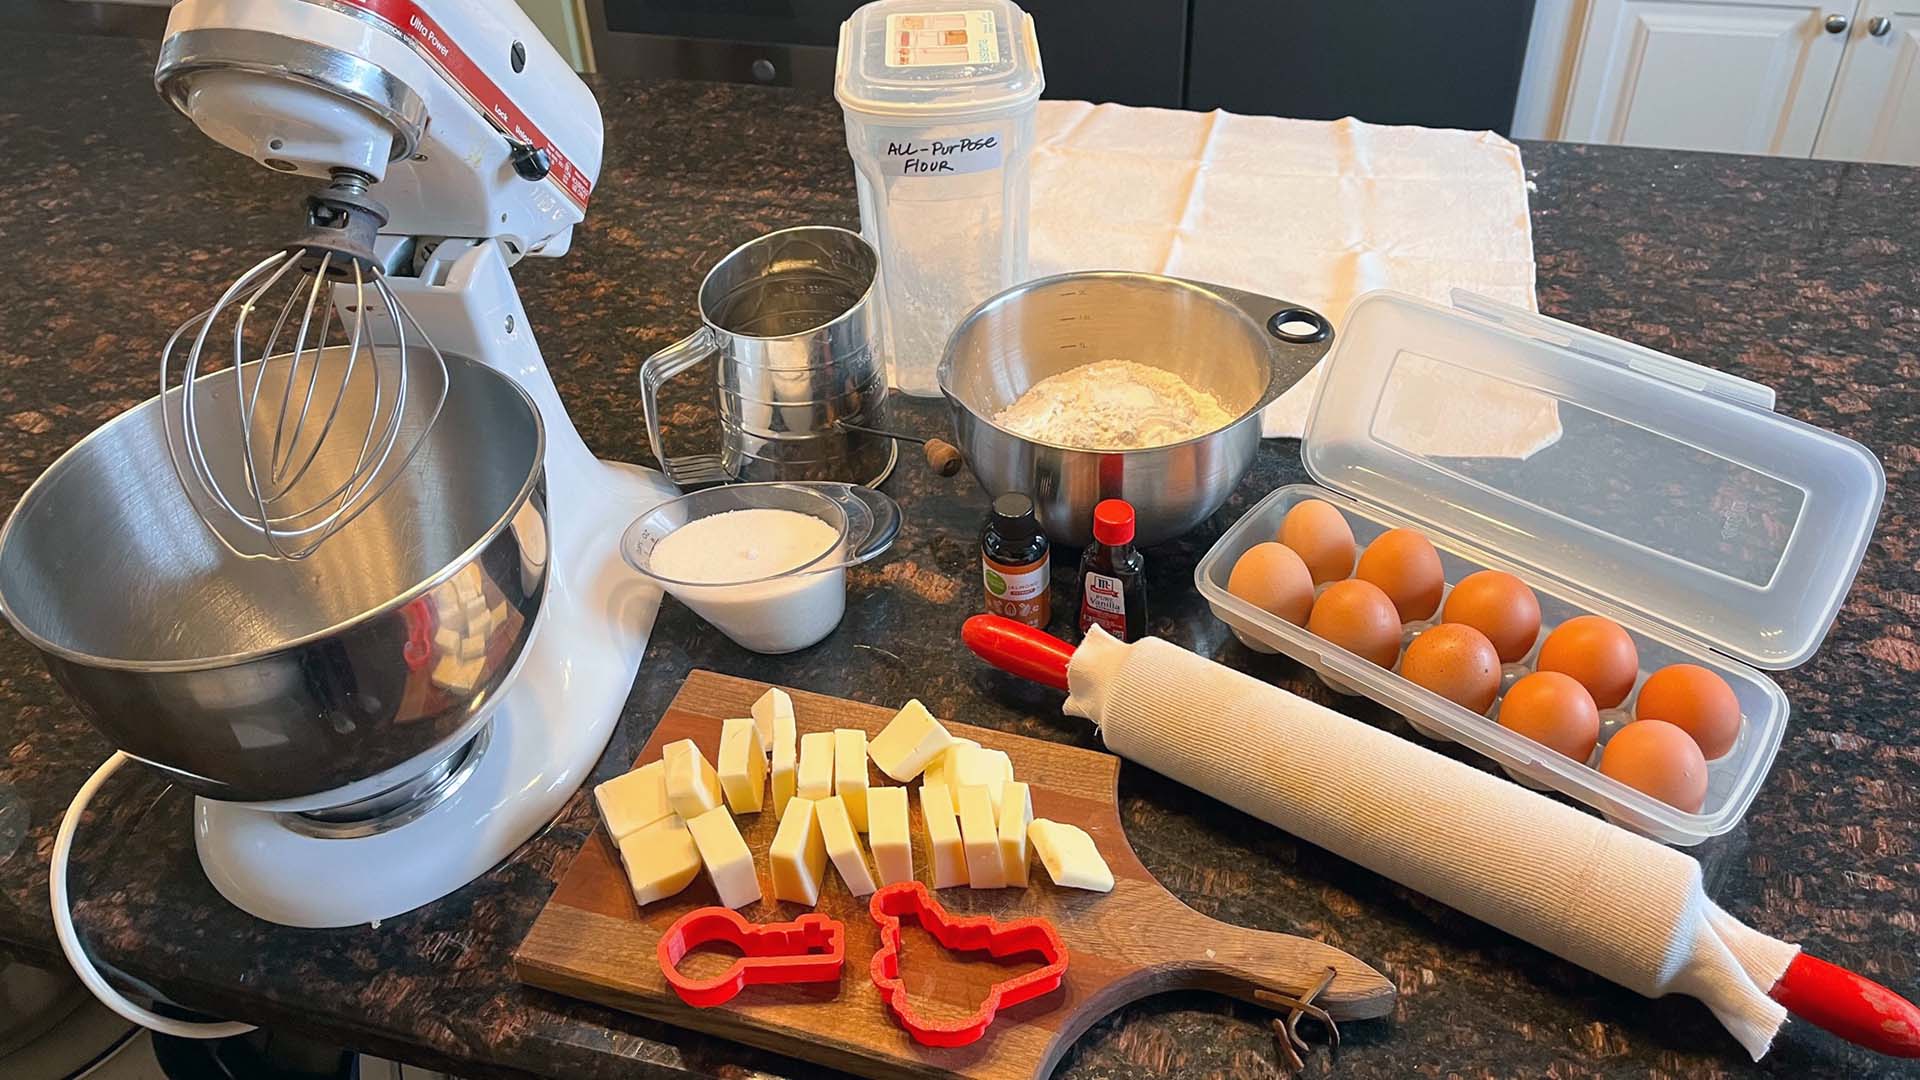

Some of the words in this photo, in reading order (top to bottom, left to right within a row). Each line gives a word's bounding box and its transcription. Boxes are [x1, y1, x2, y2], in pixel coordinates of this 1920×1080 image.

[409, 14, 429, 37] Ultra
[427, 30, 449, 57] Power
[494, 103, 509, 122] Lock
[1090, 596, 1121, 610] Vanilla
